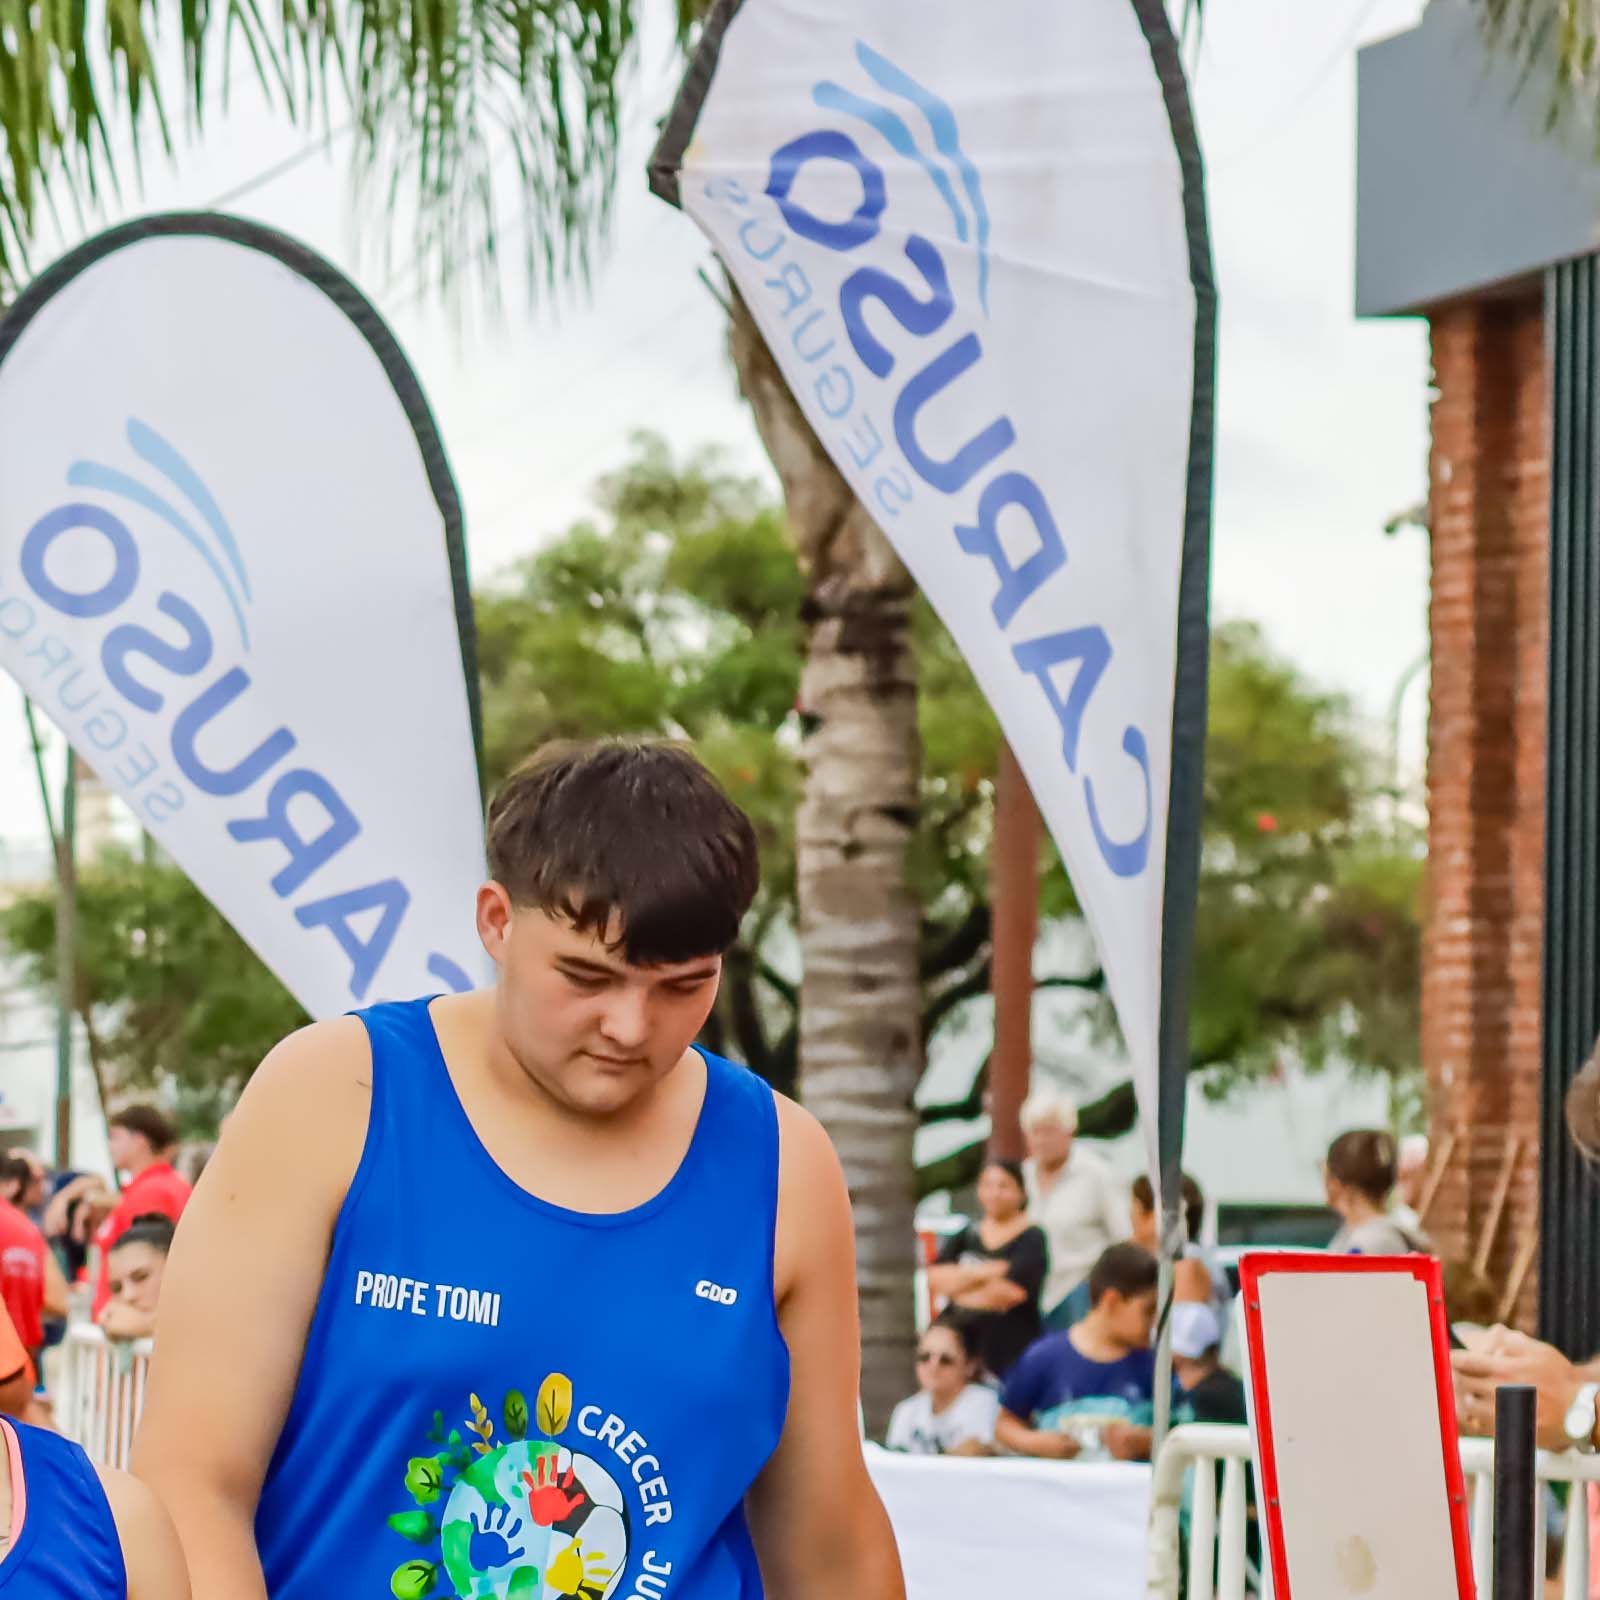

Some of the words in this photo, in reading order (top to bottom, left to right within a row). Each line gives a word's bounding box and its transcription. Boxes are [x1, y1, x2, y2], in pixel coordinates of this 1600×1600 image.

[355, 1270, 428, 1317] PROFE
[435, 1284, 502, 1327] TOMI
[694, 1279, 738, 1306] GDO
[577, 1405, 672, 1528] CRECER
